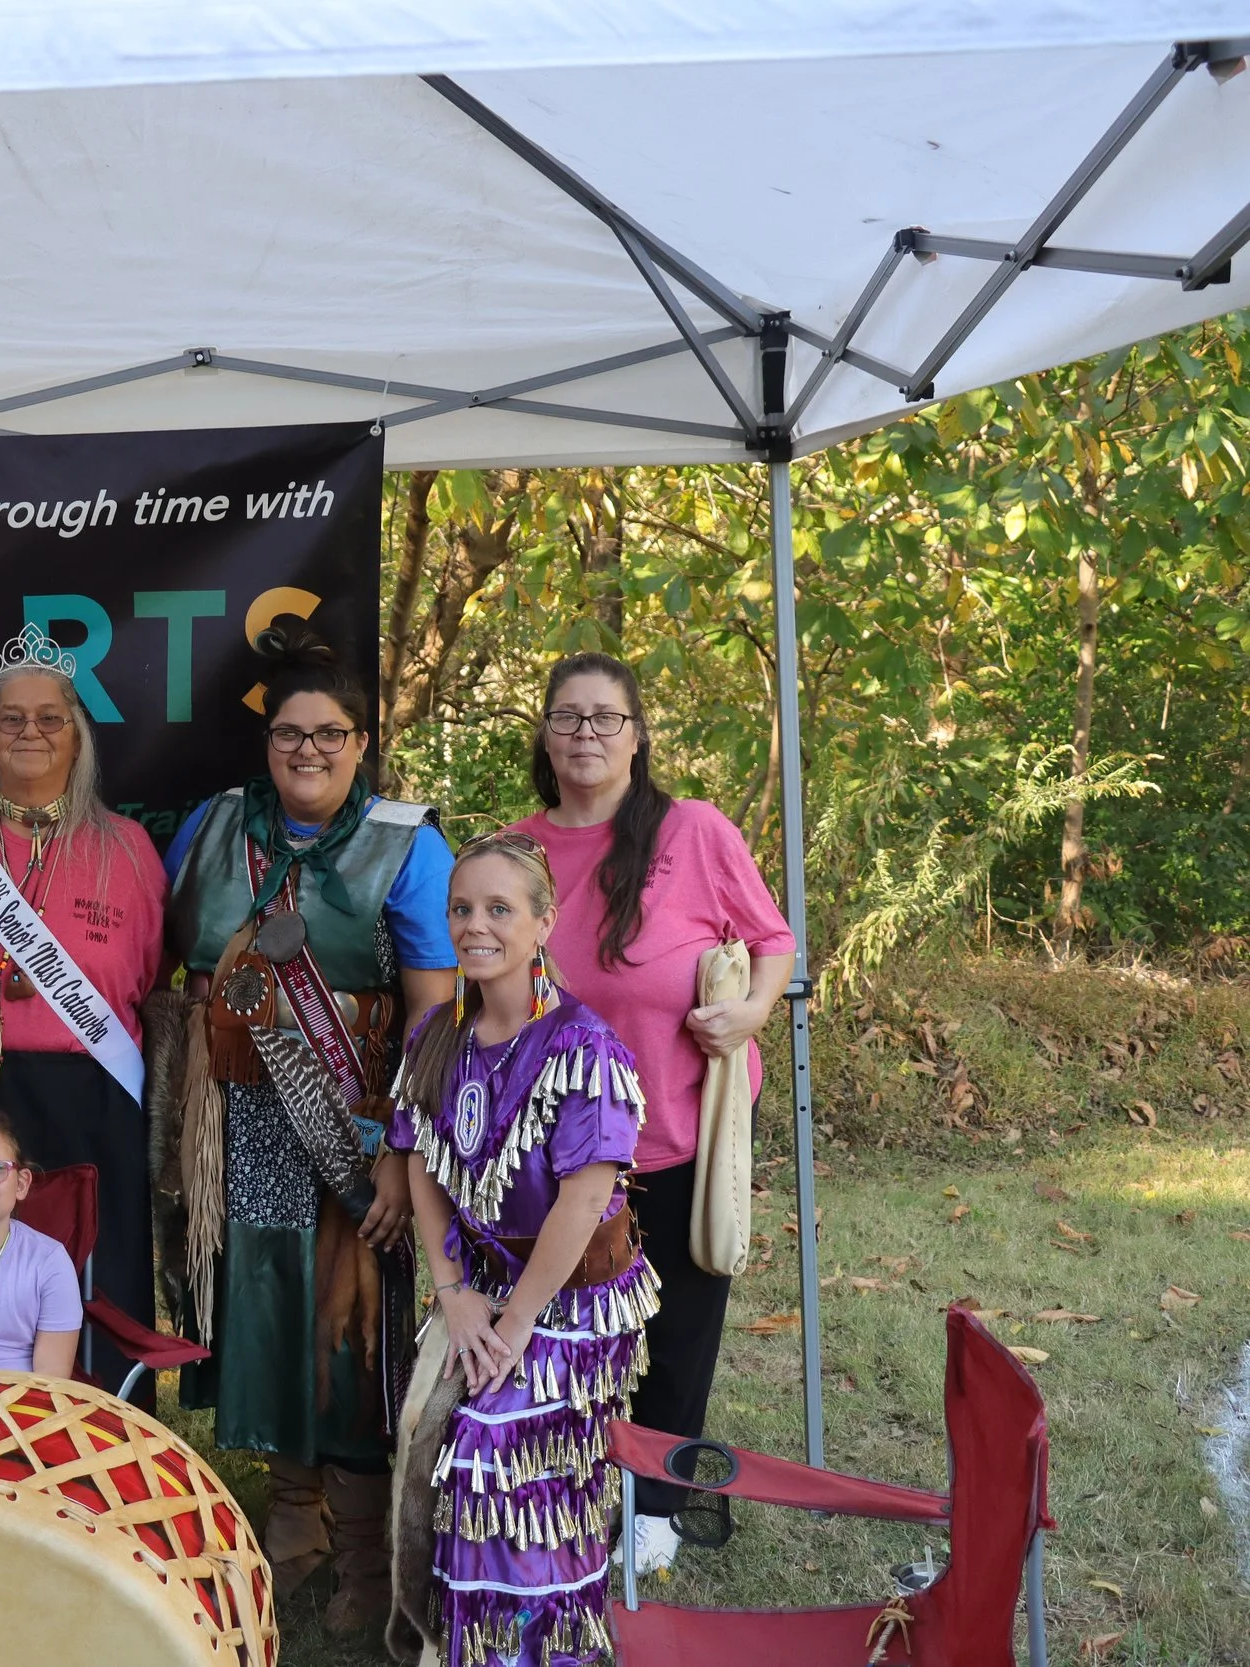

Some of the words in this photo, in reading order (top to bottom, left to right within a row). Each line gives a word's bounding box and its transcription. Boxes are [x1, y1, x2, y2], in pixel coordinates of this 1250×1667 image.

[133, 487, 230, 526] time
[245, 479, 335, 519] with
[24, 941, 68, 989] Miss
[52, 979, 111, 1045] Catawba
